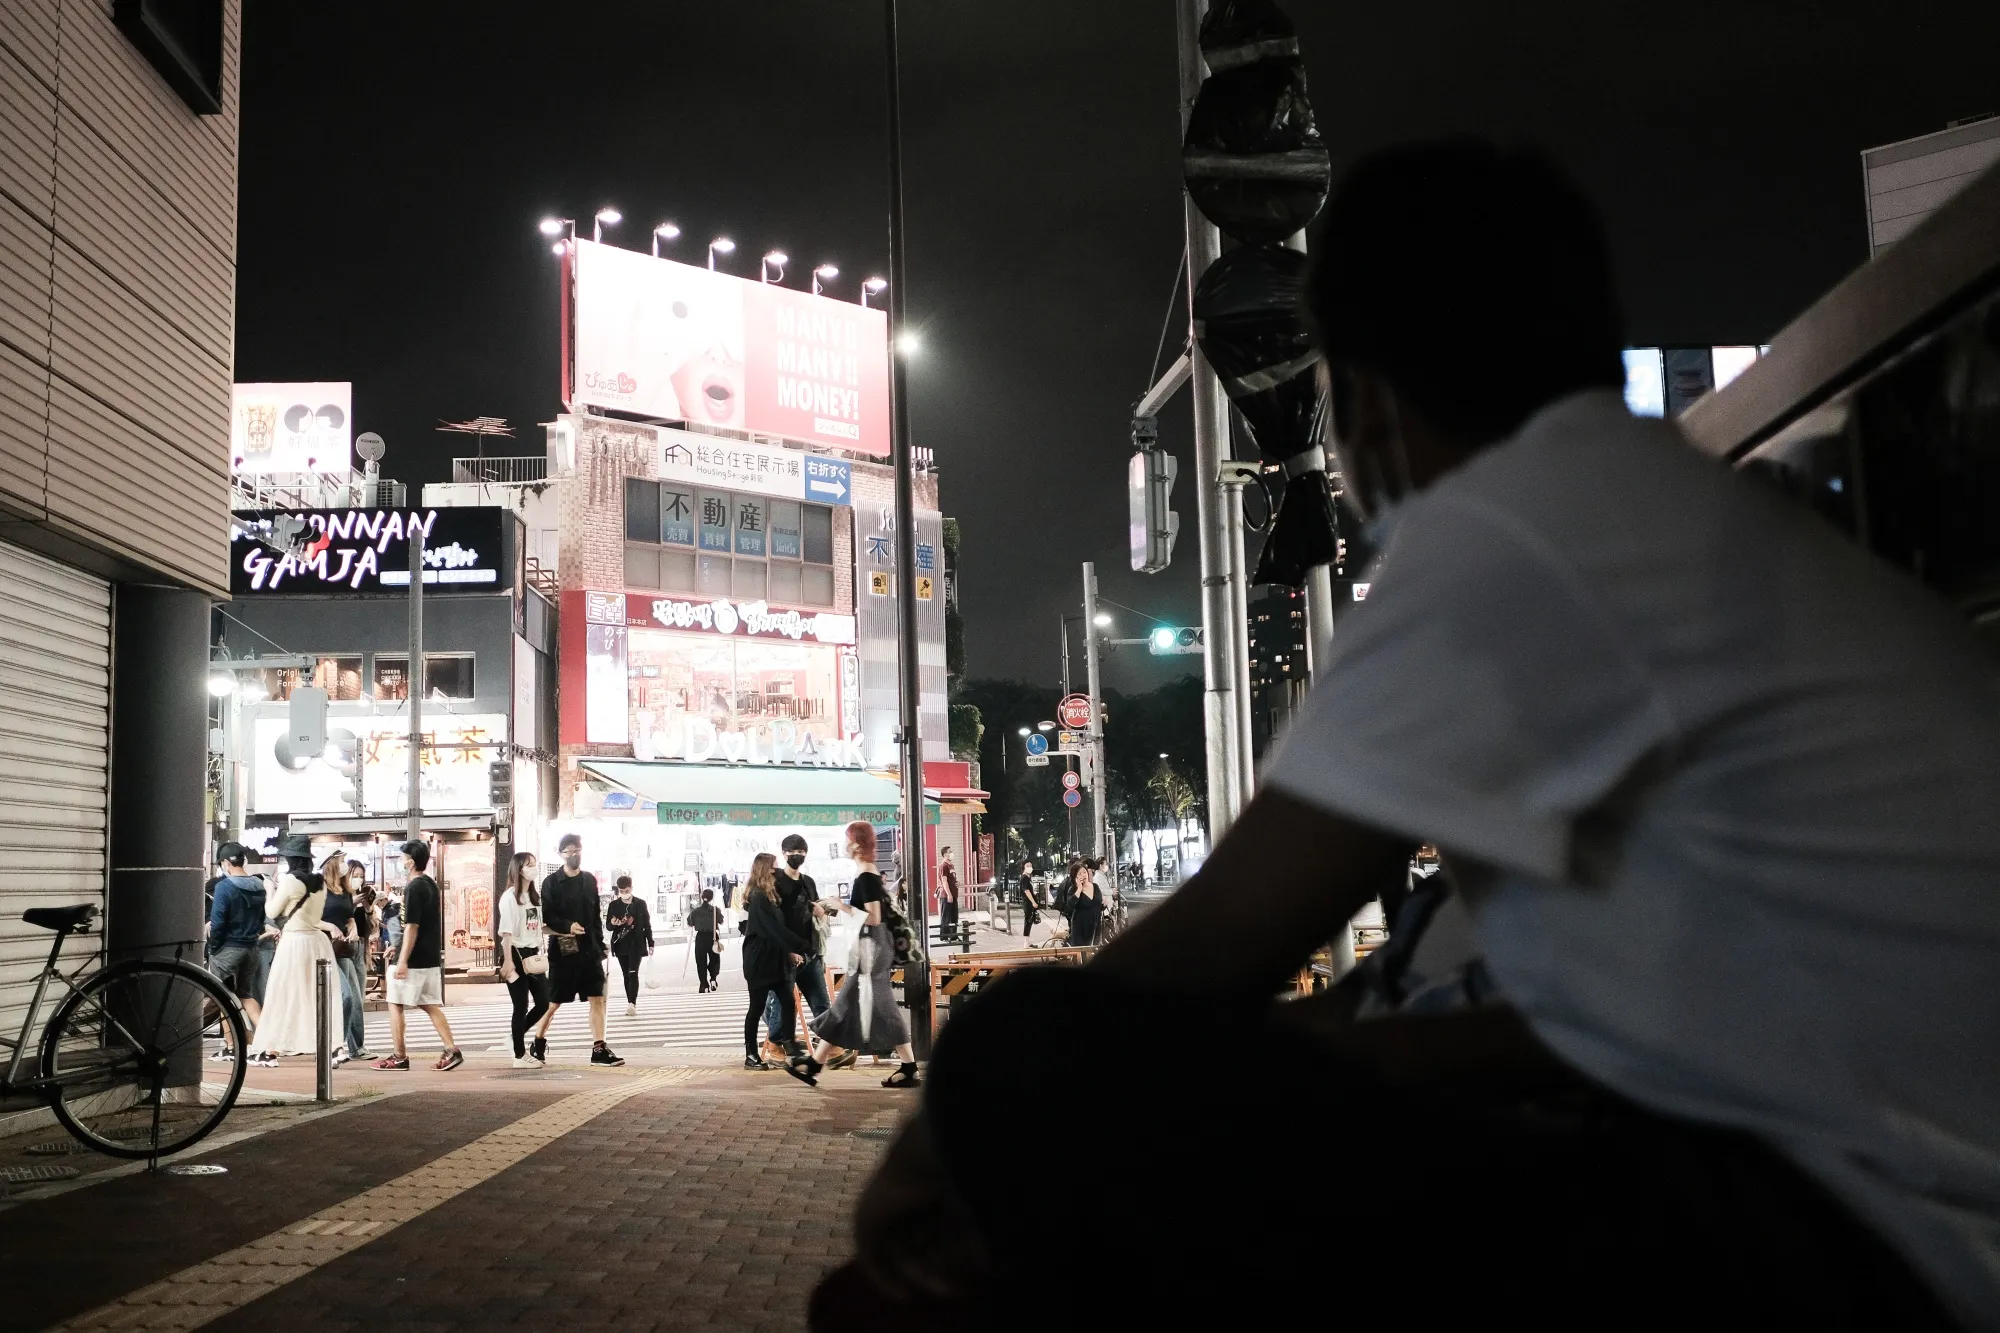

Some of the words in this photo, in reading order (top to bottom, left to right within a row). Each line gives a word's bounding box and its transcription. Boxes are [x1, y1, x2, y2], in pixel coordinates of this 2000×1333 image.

[697, 444, 800, 478] 総合住宅展示場
[807, 460, 847, 479] 右折すぐ
[666, 491, 762, 532] 不動産
[667, 527, 688, 542] 売買
[868, 536, 934, 569] 不産
[243, 546, 377, 590] GAMJA
[1066, 706, 1090, 719] 消火栓
[1066, 776, 1077, 785] 40
[665, 808, 700, 822] K-POP
[860, 810, 888, 823] K-POP
[968, 981, 979, 993] 新
